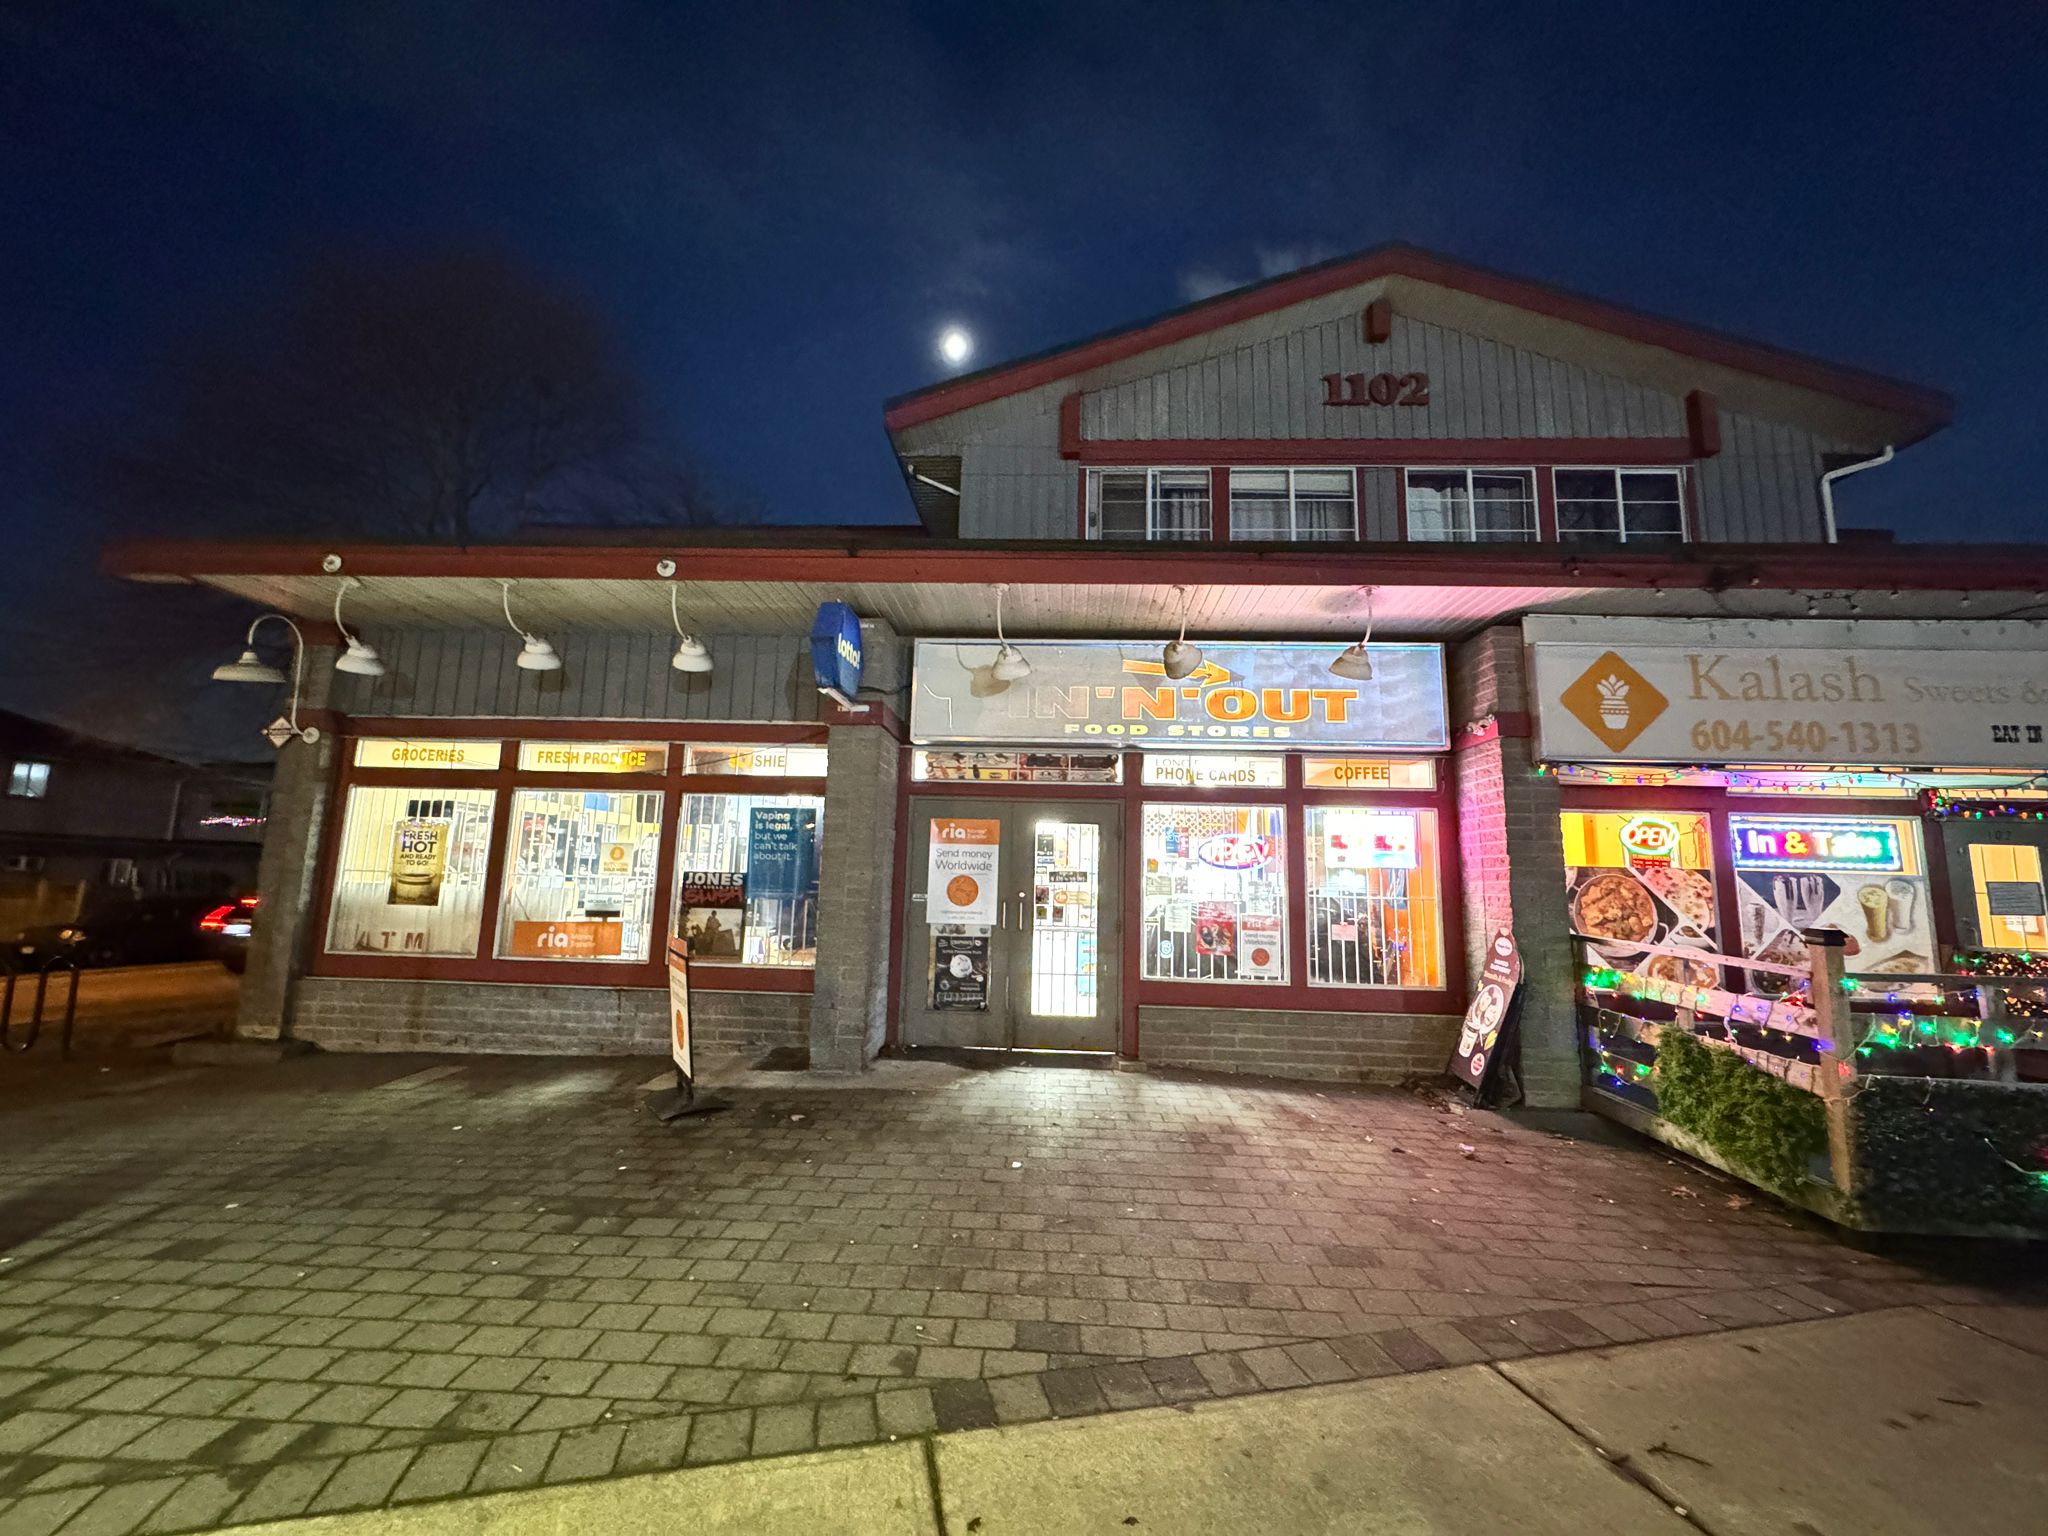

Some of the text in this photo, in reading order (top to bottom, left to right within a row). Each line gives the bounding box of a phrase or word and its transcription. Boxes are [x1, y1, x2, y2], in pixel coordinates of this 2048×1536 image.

[1322, 372, 1429, 406] 1102
[1683, 654, 2048, 705] Kalash Sweets &
[1064, 723, 1291, 739] FOOD STORES
[1689, 719, 1923, 754] 604-540-1313
[1991, 725, 2043, 743] EAT IN
[391, 748, 465, 763] GROCERIES
[537, 751, 579, 764] FRESH
[1334, 766, 1391, 780] COFFEE
[755, 811, 791, 821] Vaping
[755, 820, 793, 831] is legal,
[941, 822, 966, 839] ria
[403, 830, 438, 841] FRESH
[755, 831, 771, 840] but
[1628, 826, 1674, 848] OPEN
[1748, 830, 1777, 854] In
[1784, 831, 1808, 855] &
[401, 840, 437, 853] HOT
[753, 842, 798, 850] can't talk
[753, 852, 780, 860] about
[935, 848, 993, 860] Send money
[935, 859, 993, 871] Worldwide
[686, 872, 743, 886] JONES
[537, 925, 569, 948] ria
